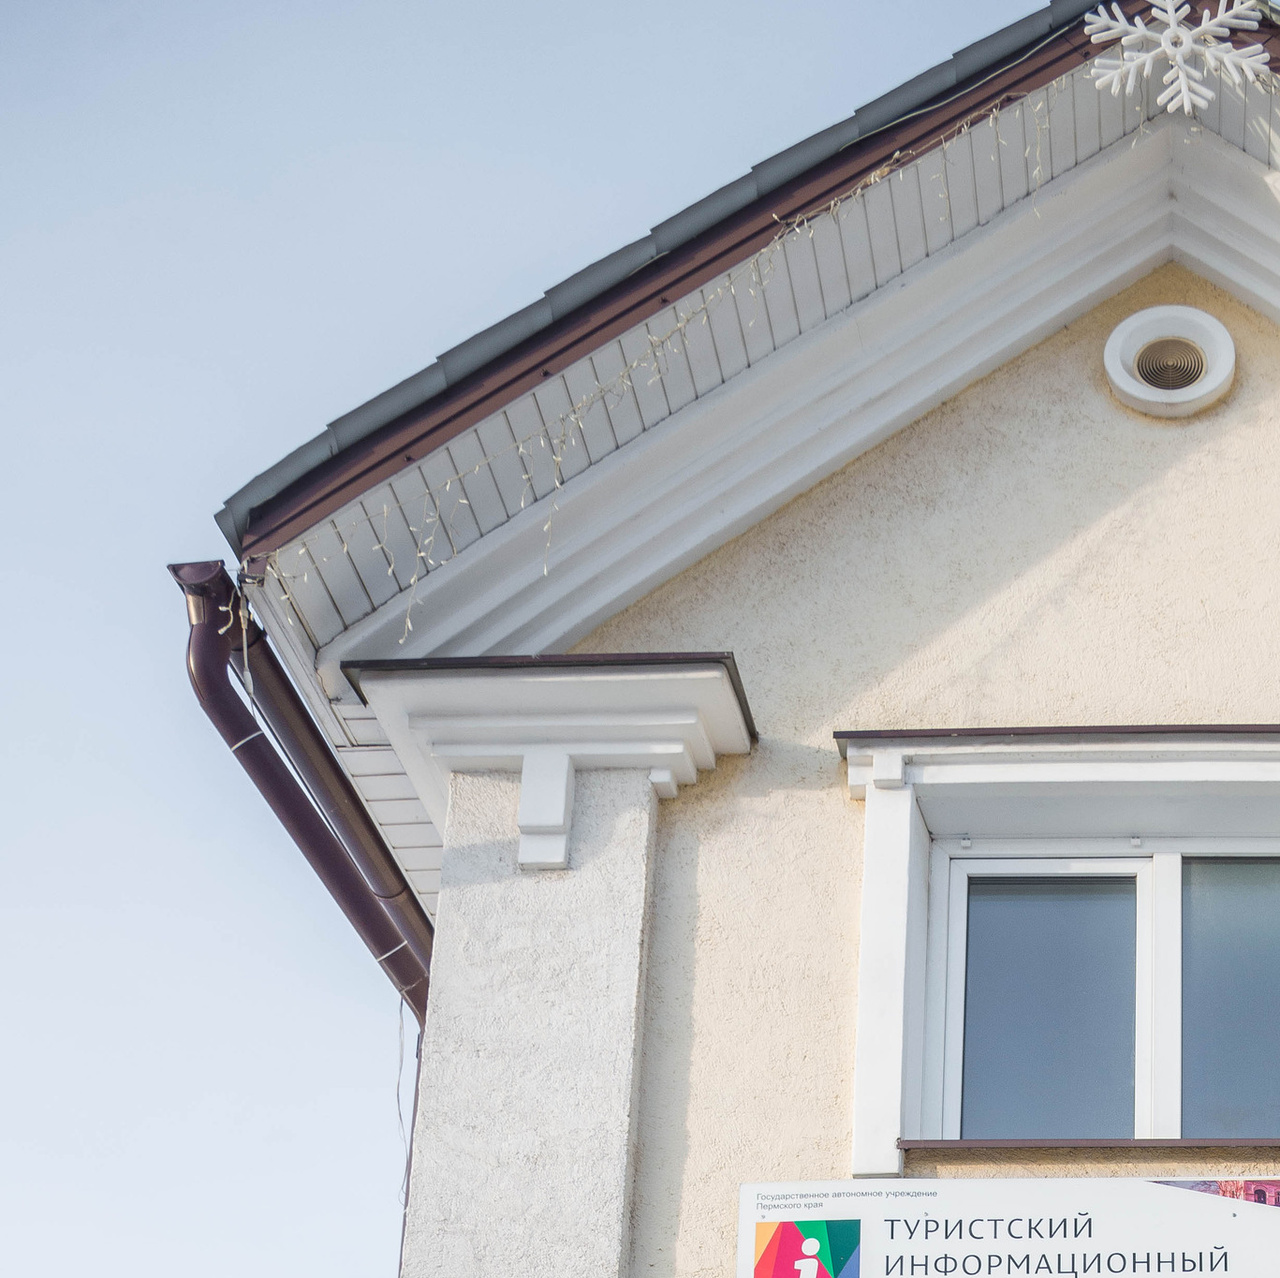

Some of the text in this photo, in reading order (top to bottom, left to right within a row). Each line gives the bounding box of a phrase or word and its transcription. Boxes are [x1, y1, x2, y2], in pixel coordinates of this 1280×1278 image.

[756, 1190, 937, 1201] Государственное автономное учреждение
[756, 1202, 823, 1211] Пермского края
[884, 1211, 1093, 1240] ТУРИСТСКИЙ
